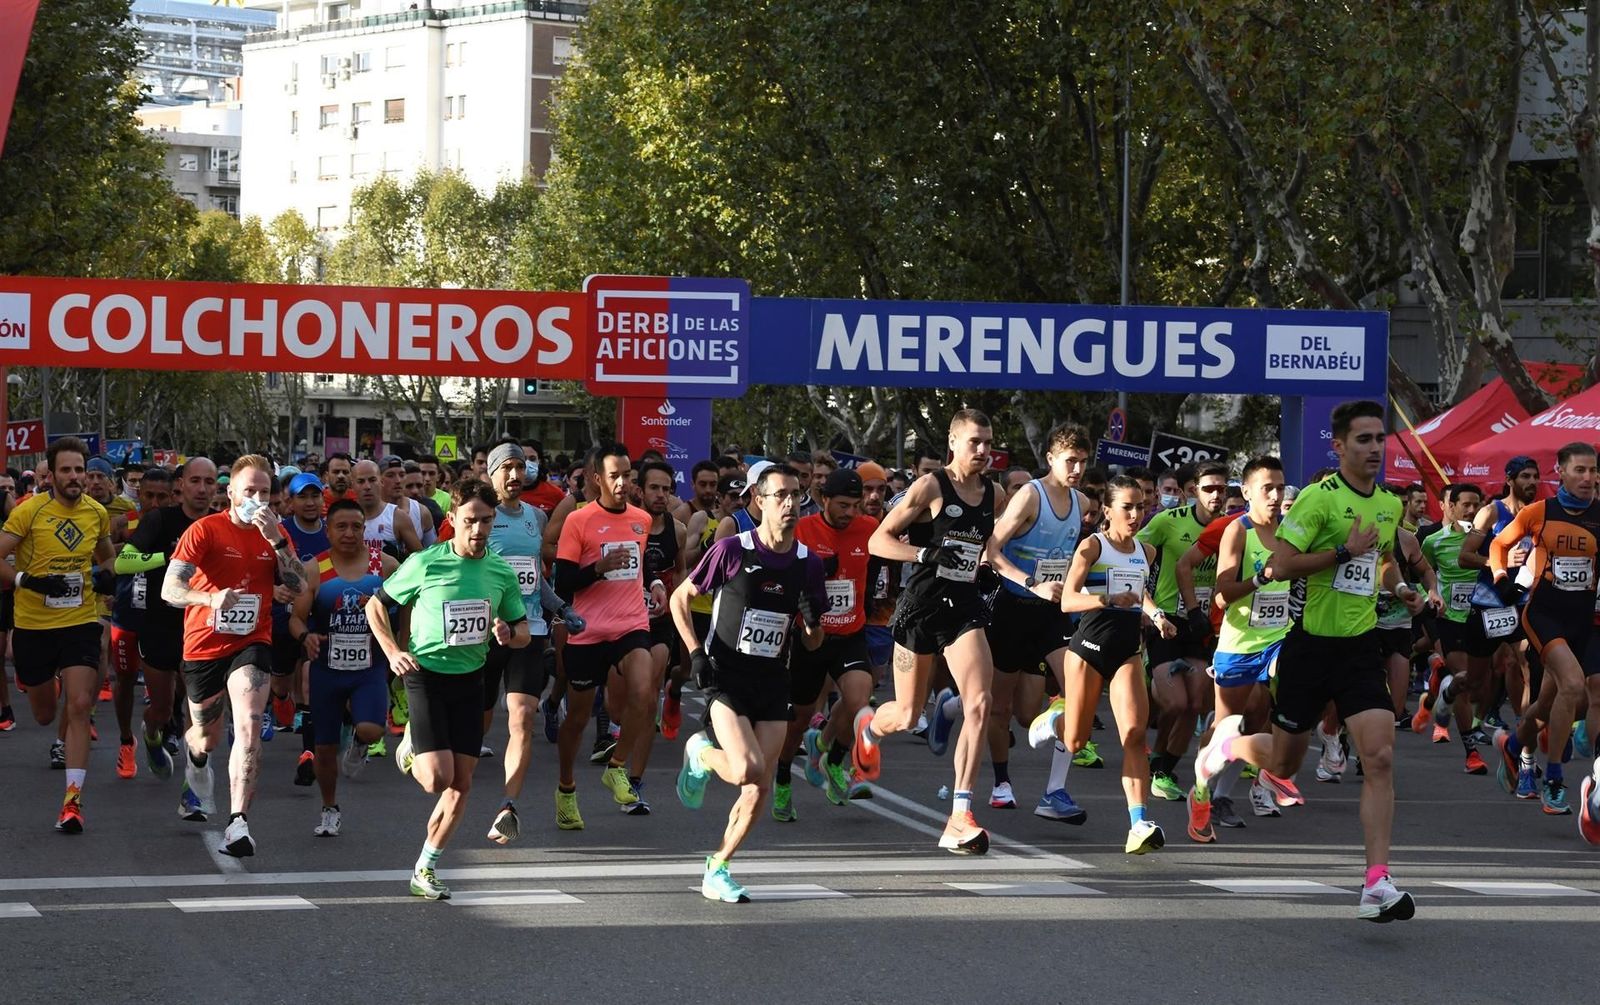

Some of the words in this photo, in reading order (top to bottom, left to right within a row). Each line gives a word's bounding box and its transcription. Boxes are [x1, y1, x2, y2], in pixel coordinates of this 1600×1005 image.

[48, 293, 573, 364] COLCHONEROS
[598, 312, 678, 334] DERBI
[685, 318, 705, 330] DE
[711, 318, 739, 331] LAS
[597, 338, 739, 361] AFICIONES
[816, 313, 1235, 379] MERENGUES
[1301, 336, 1331, 351] DEL
[1270, 351, 1361, 370] BERNABÉU
[641, 416, 692, 426] Santander
[1557, 535, 1587, 551] FILE
[959, 559, 977, 572] 98
[518, 571, 535, 585] 66
[1344, 564, 1371, 583] 694
[1562, 571, 1588, 583] 350
[220, 609, 255, 624] 5222
[1259, 605, 1285, 619] 599
[329, 613, 343, 628] LA
[449, 616, 487, 634] 2370
[1488, 615, 1517, 630] 2239
[337, 624, 368, 633] MADRID
[741, 626, 784, 646] 2040
[1081, 640, 1101, 652] HOKA
[333, 647, 367, 661] 3190
